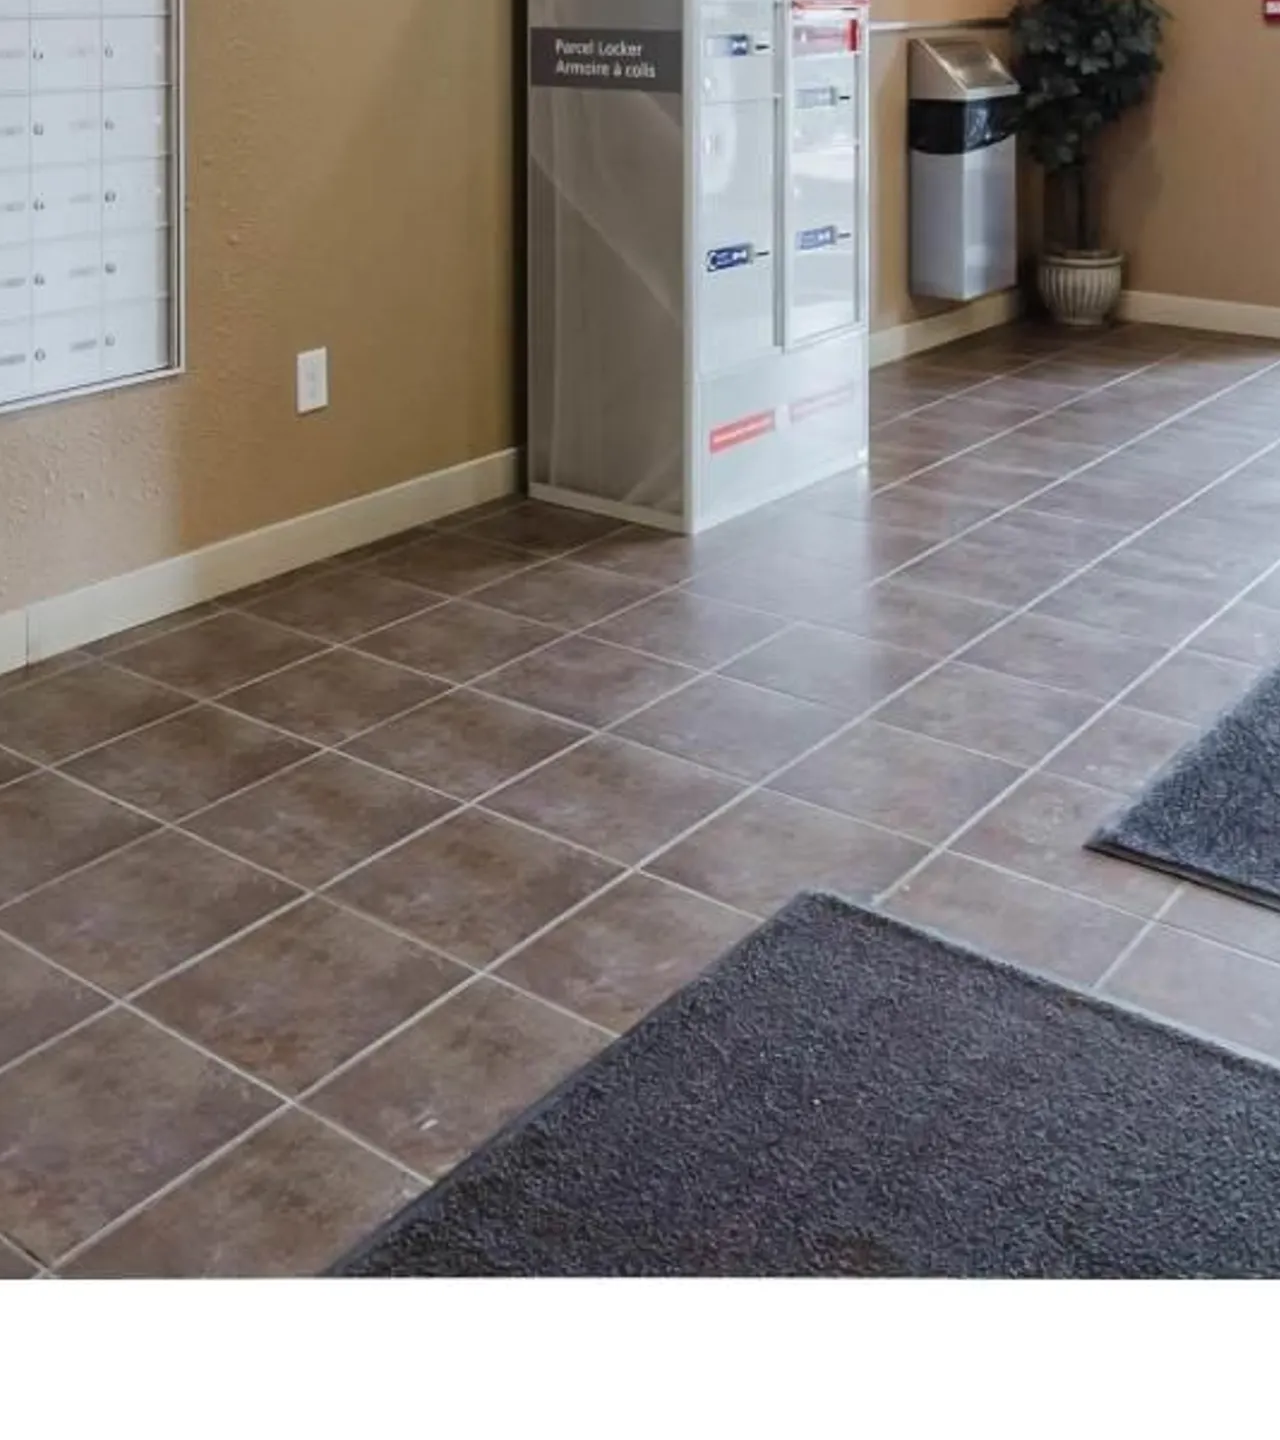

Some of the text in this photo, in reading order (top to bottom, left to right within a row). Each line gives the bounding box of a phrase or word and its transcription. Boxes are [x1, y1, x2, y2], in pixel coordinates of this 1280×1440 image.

[554, 38, 643, 57] Parcel Locker
[555, 57, 610, 77] Armoire
[625, 61, 657, 79] colis
